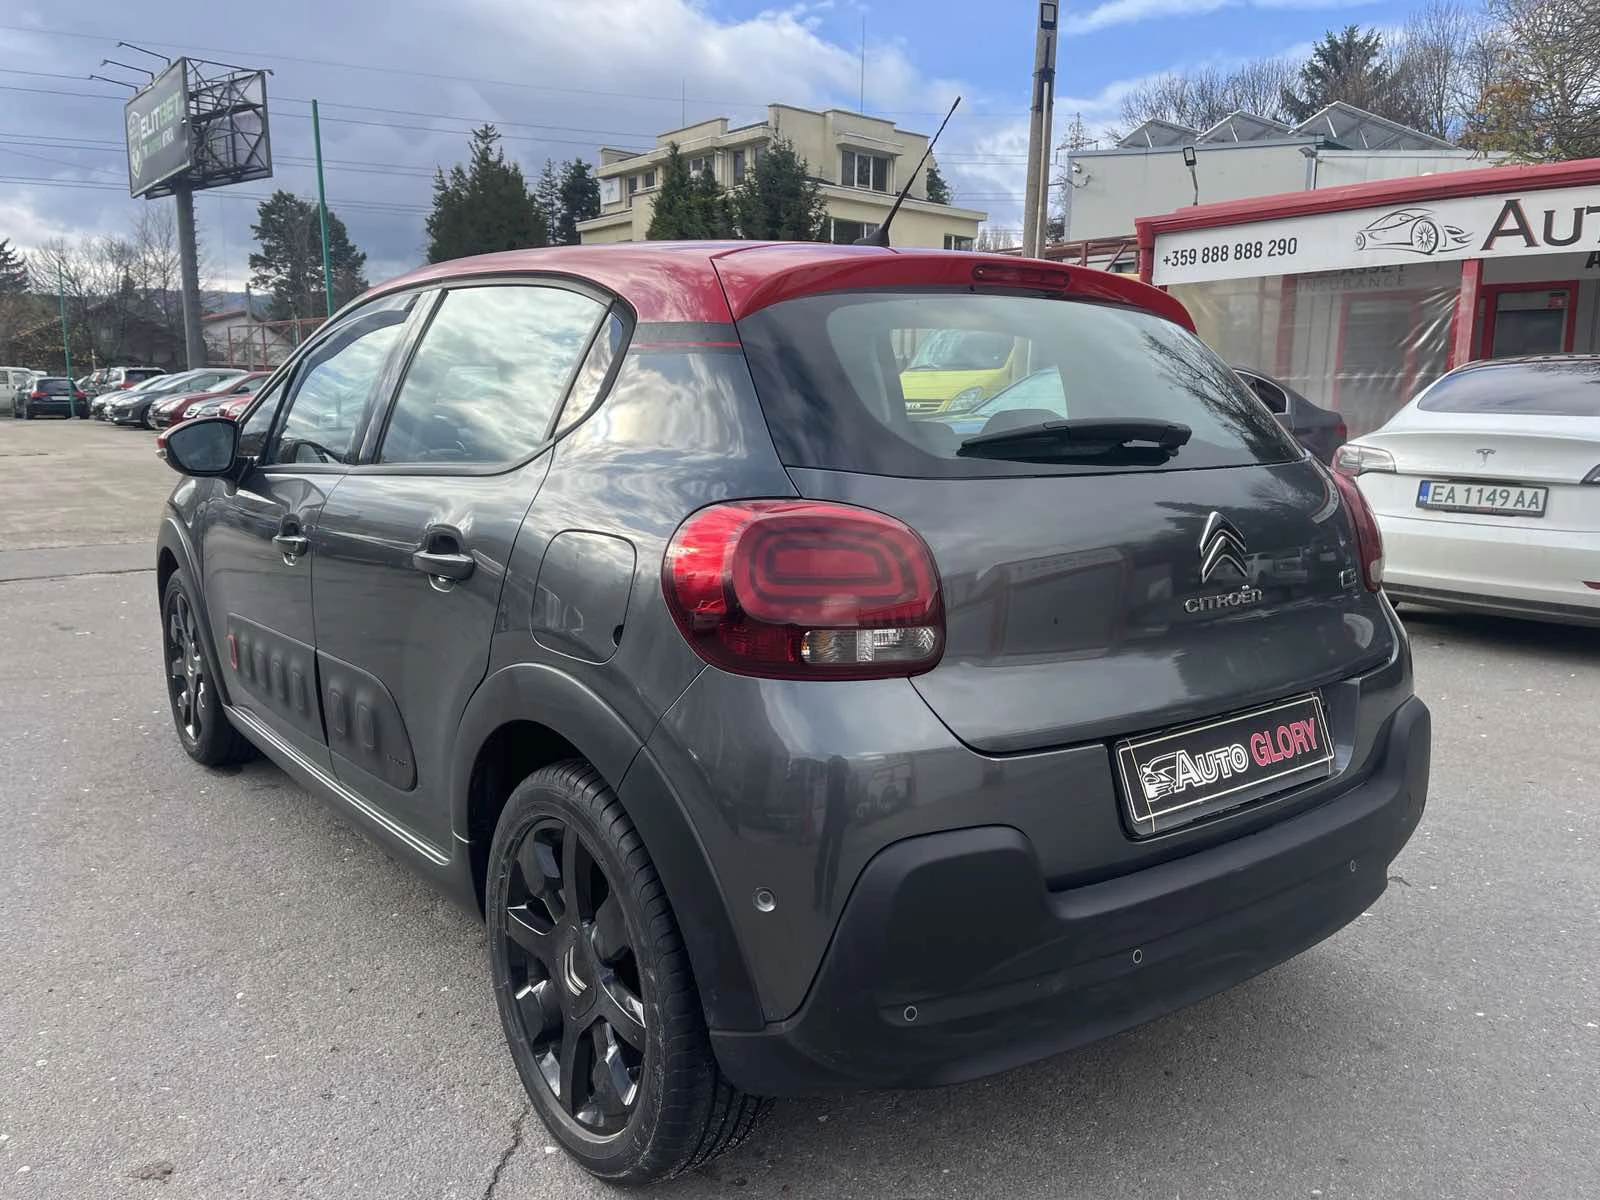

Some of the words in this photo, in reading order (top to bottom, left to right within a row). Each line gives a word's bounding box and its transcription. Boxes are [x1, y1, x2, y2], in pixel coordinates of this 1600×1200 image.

[1163, 248, 1197, 267] +359
[1202, 244, 1229, 264] 888
[1234, 241, 1263, 261] 888
[1268, 237, 1298, 257] 290
[1431, 485, 1456, 503] EA
[1464, 487, 1511, 506] 1149
[1513, 490, 1539, 509] AA
[1250, 717, 1318, 767] GLORY
